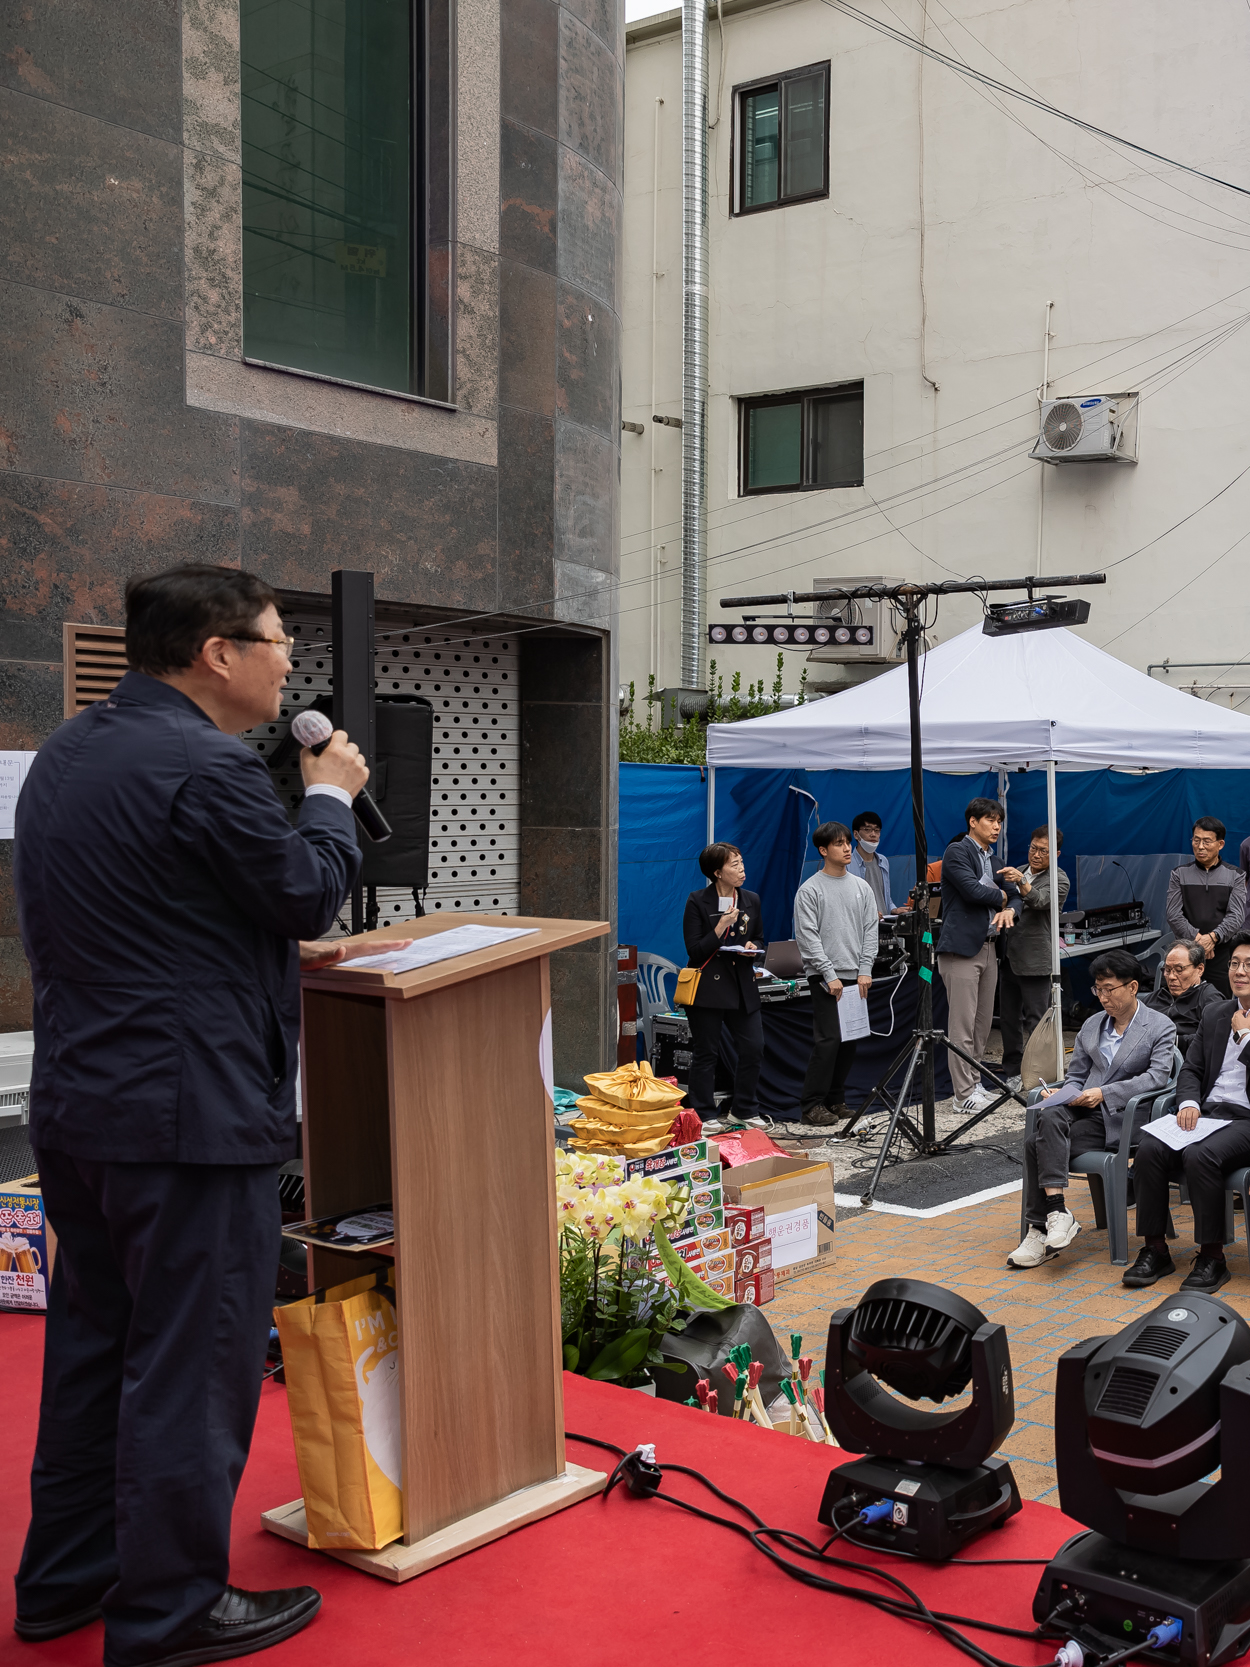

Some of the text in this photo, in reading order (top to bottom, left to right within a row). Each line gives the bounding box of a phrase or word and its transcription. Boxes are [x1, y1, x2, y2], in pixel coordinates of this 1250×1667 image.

[0, 1196, 40, 1210] 신성전통시장
[0, 1210, 41, 1226] 주축제
[768, 1218, 810, 1239] 행운권경품
[1, 1274, 34, 1287] 한잔 천원
[355, 1312, 384, 1341] I'M
[376, 1336, 388, 1352] &
